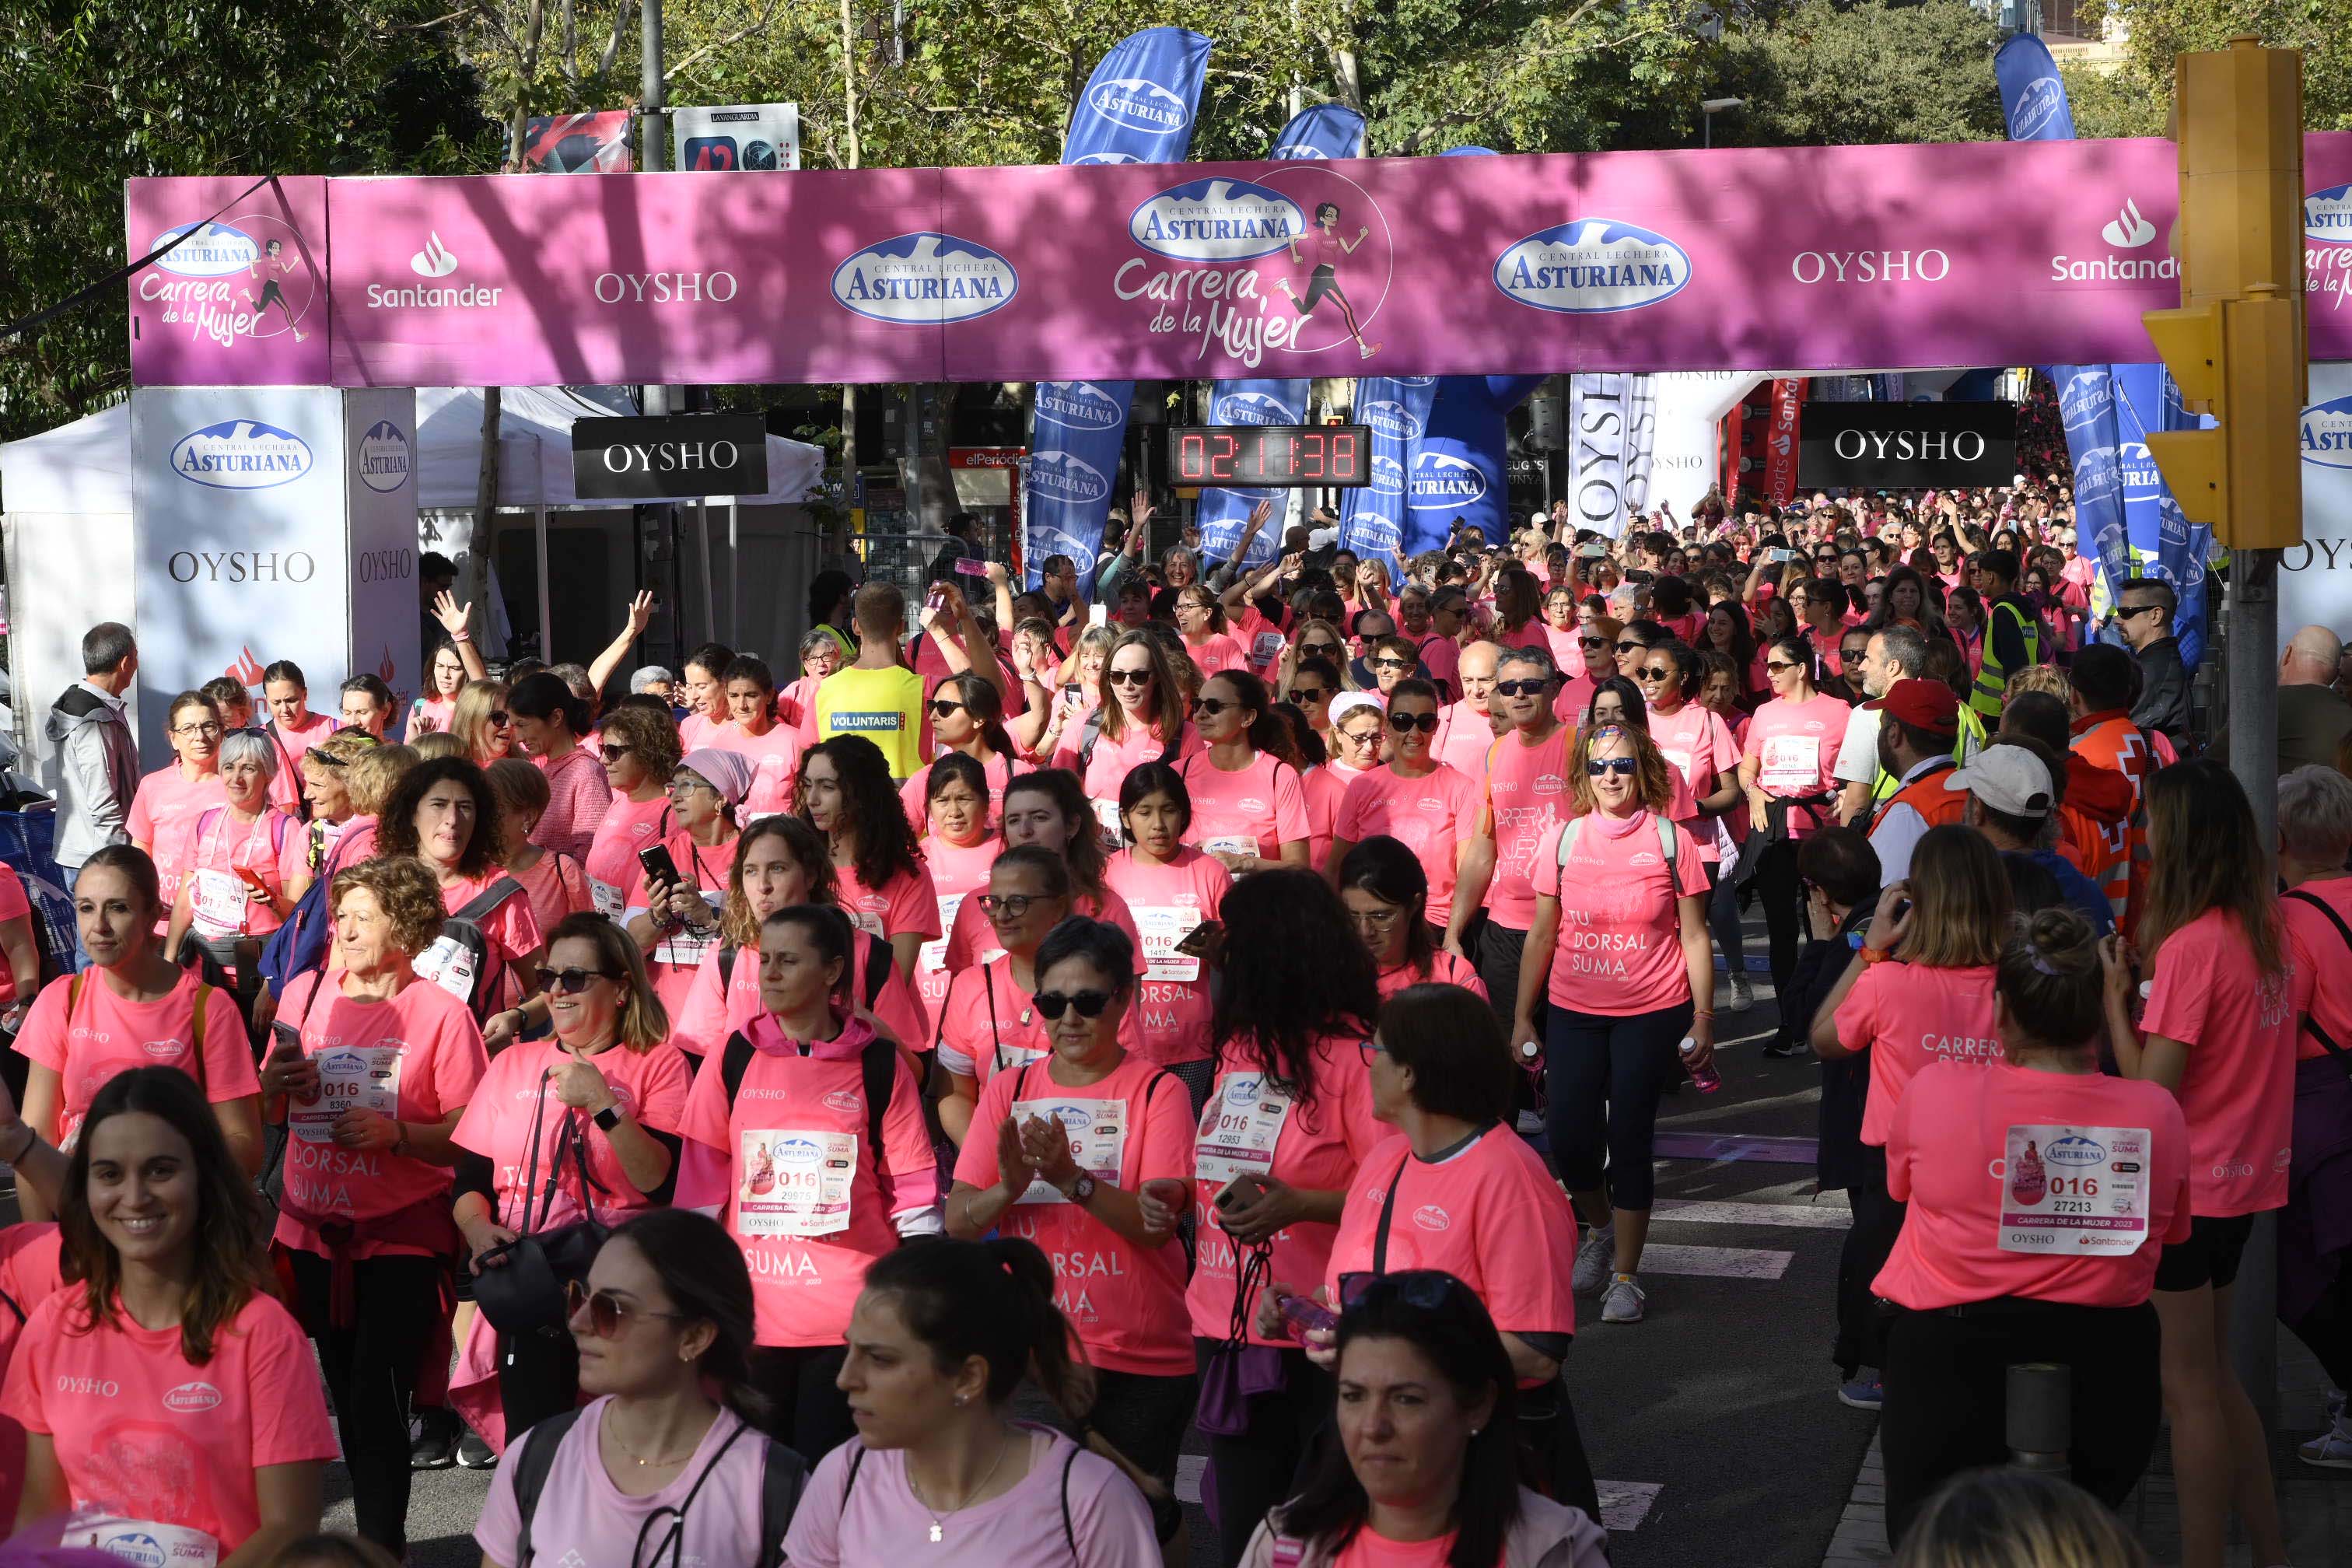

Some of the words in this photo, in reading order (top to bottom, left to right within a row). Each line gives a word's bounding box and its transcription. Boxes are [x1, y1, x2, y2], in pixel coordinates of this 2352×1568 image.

[1095, 88, 1181, 126] ASTURIANA
[1169, 205, 1225, 215] CENTRAL
[1229, 205, 1287, 214] LECHERA
[1142, 209, 1291, 240] ASTURIANA
[1539, 252, 1599, 262] CENTRAL
[1607, 250, 1668, 260] LECHERA
[1792, 249, 1950, 283] OYSHO
[874, 264, 933, 273] CENTRAL
[939, 263, 997, 272] LECHERA
[1508, 255, 1675, 289] ASTURIANA
[2051, 255, 2181, 281] Santand
[140, 273, 231, 302] Carrera
[594, 271, 737, 303] OYSHO
[845, 267, 1003, 300] ASTURIANA
[1114, 257, 1260, 301] Carrera
[2323, 271, 2337, 292] la
[367, 282, 502, 307] Santander
[162, 304, 179, 324] de
[183, 304, 194, 324] la
[193, 299, 266, 348] Mujer
[1150, 302, 1175, 333] de
[1182, 303, 1201, 333] la
[1198, 296, 1314, 368] Mujer
[1035, 389, 1113, 424] ASTURIANA
[1835, 429, 1984, 460] OYSHO
[182, 446, 302, 471] ASTURIANA
[362, 448, 408, 474] ASTURIANA
[604, 440, 737, 473] OYSHO
[1181, 436, 1355, 478] 02:11:38
[1651, 456, 1703, 468] YSHO
[1030, 470, 1098, 497] STURIANA
[169, 551, 315, 582] OYSHO
[359, 548, 411, 583] OYSHO
[832, 717, 897, 726] VOLUNTARIS
[1573, 856, 1605, 866] OYSHO
[1568, 910, 1590, 926] TU
[1145, 936, 1172, 947] 016
[1574, 933, 1647, 951] DORSAL
[1572, 954, 1629, 975] SUMA
[1140, 984, 1193, 1003] ORSAL
[325, 1061, 363, 1072] ASTURIANA
[324, 1082, 359, 1097] 016
[742, 1089, 786, 1100] OYSHO
[824, 1097, 860, 1109] ASTURIANA
[1221, 1114, 1248, 1132] 016
[1217, 1133, 1241, 1145] 12953
[293, 1141, 380, 1176] DORSAL
[777, 1147, 820, 1158] ASTURIANA
[2049, 1147, 2102, 1160] ASTURIANA
[1198, 1162, 1213, 1171] SHO
[779, 1172, 816, 1186] 016
[2050, 1177, 2098, 1195] 016
[293, 1174, 352, 1207] SUMA
[782, 1191, 811, 1200] 29975
[2054, 1201, 2091, 1213] 27213
[749, 1219, 784, 1227] OYSHO
[2012, 1234, 2055, 1244] OYSHO
[2091, 1237, 2135, 1247] Santander
[744, 1248, 818, 1276] SUMA
[1053, 1251, 1124, 1277] RSAL
[58, 1375, 119, 1398] OYSHO
[167, 1394, 215, 1405] ASTURIANA
[173, 1548, 205, 1559] SUMA
